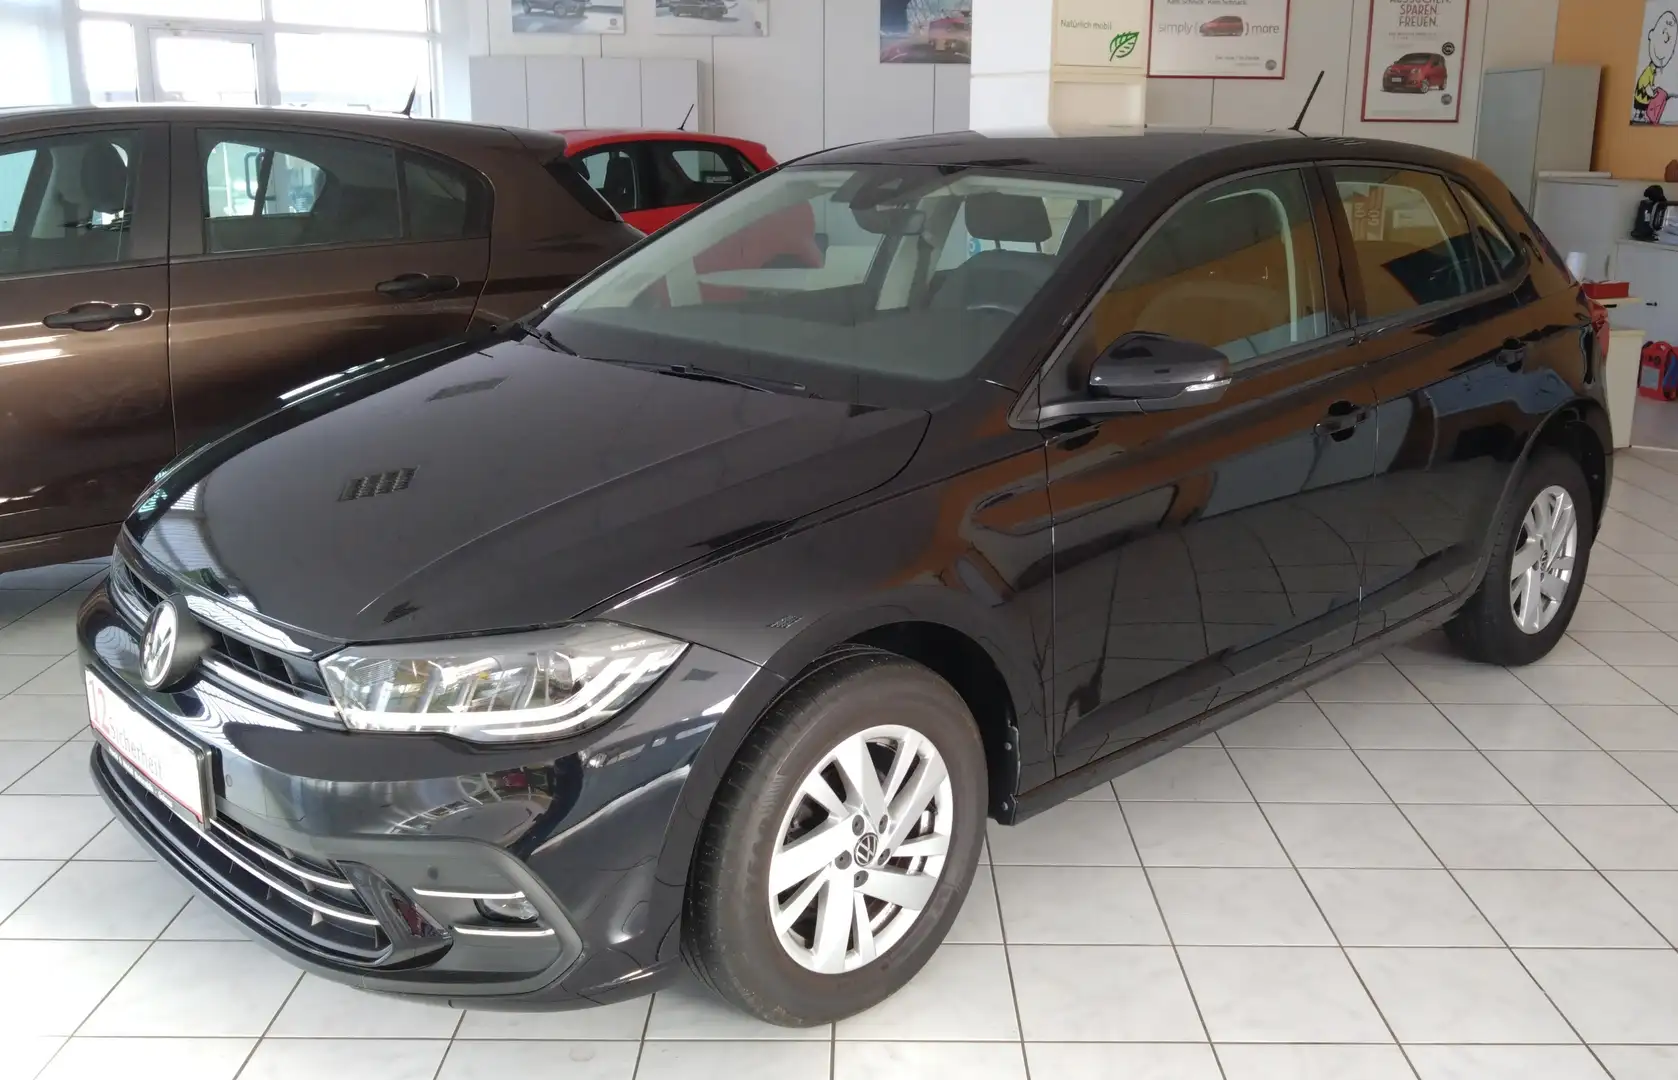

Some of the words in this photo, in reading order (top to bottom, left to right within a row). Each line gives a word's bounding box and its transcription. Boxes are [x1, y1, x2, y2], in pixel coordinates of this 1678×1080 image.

[1060, 19, 1092, 29] Natürlich
[1093, 21, 1113, 31] mobil
[1251, 24, 1280, 34] more
